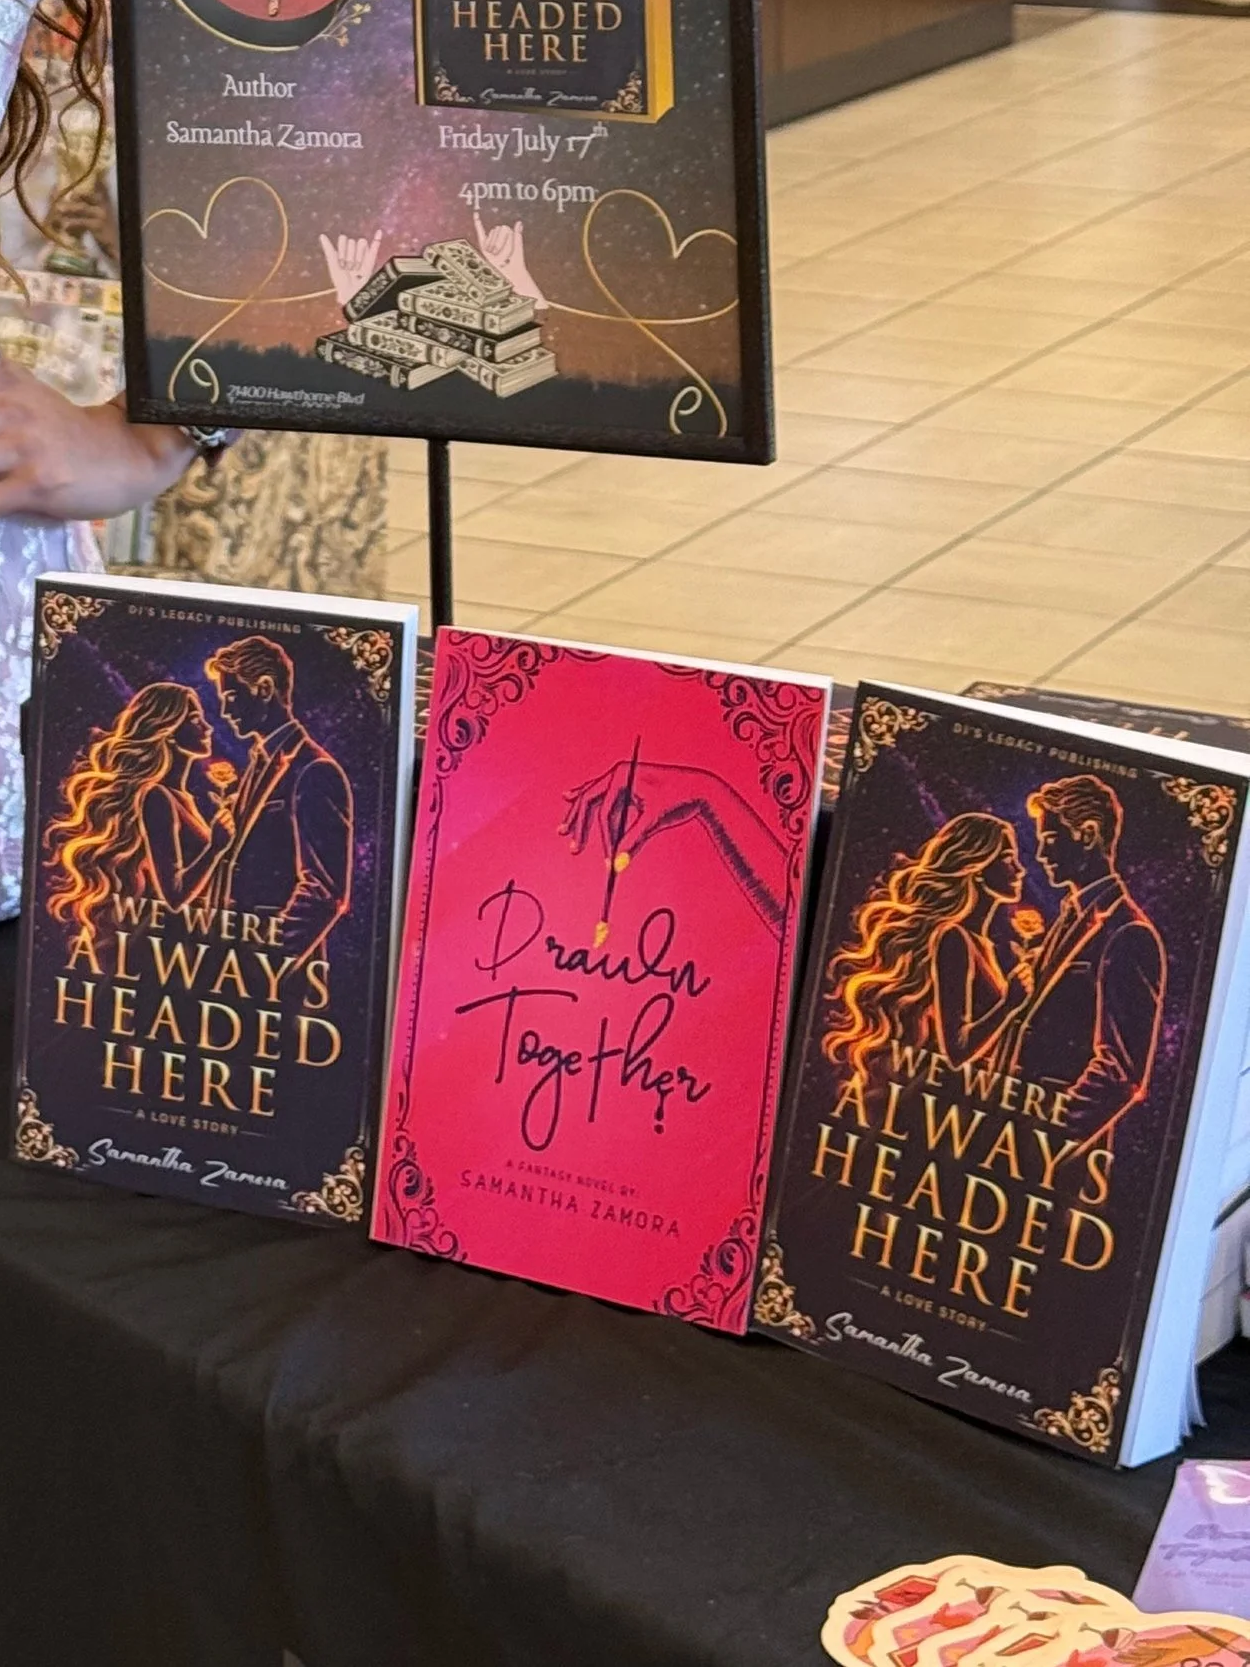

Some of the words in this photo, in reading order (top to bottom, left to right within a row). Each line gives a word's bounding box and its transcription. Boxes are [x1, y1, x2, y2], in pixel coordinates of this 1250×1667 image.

[452, 0, 623, 32] HEADED
[483, 33, 589, 63] HERE
[221, 72, 298, 99] Author
[166, 120, 275, 148] Samantha
[276, 123, 364, 151] Zamora
[438, 123, 510, 162] Friday
[511, 123, 562, 163] July
[457, 181, 512, 211] 4pm
[514, 181, 540, 201] to
[541, 177, 598, 214] 6pm
[267, 387, 337, 403] Hawthorne
[337, 390, 366, 405] Blvd
[160, 608, 213, 625] LEGACY
[217, 615, 302, 634] PUBLISHING
[986, 731, 1047, 756] LEGACY
[1049, 746, 1139, 780] PUBLISHING
[112, 892, 169, 930] WE
[181, 904, 286, 948] WERE
[474, 879, 712, 998] Drawn
[64, 926, 331, 1011] ALWAYS
[54, 975, 344, 1068] HEADED
[101, 1040, 277, 1118] HERE
[454, 985, 713, 1152] Together
[890, 1039, 950, 1088] WE
[961, 1060, 1075, 1128] WERE
[134, 1108, 146, 1121] A
[150, 1111, 188, 1129] LOVE
[191, 1117, 241, 1136] STORY
[829, 1072, 1116, 1207] ALWAYS
[86, 1137, 198, 1174] Samantha
[199, 1160, 291, 1191] Zamora
[505, 1159, 514, 1169] A
[517, 1160, 572, 1184] FANTASY
[576, 1175, 615, 1195] NOVEL
[459, 1168, 579, 1214] SAMANTHA
[590, 1199, 681, 1238] ZAMORA
[810, 1122, 1116, 1272] HEADED
[849, 1201, 1039, 1320] HERE
[880, 1284, 893, 1299] A
[895, 1289, 935, 1315] LOVE
[937, 1302, 989, 1335] STORY
[824, 1311, 935, 1368] Samantha
[936, 1355, 1034, 1406] Zamora
